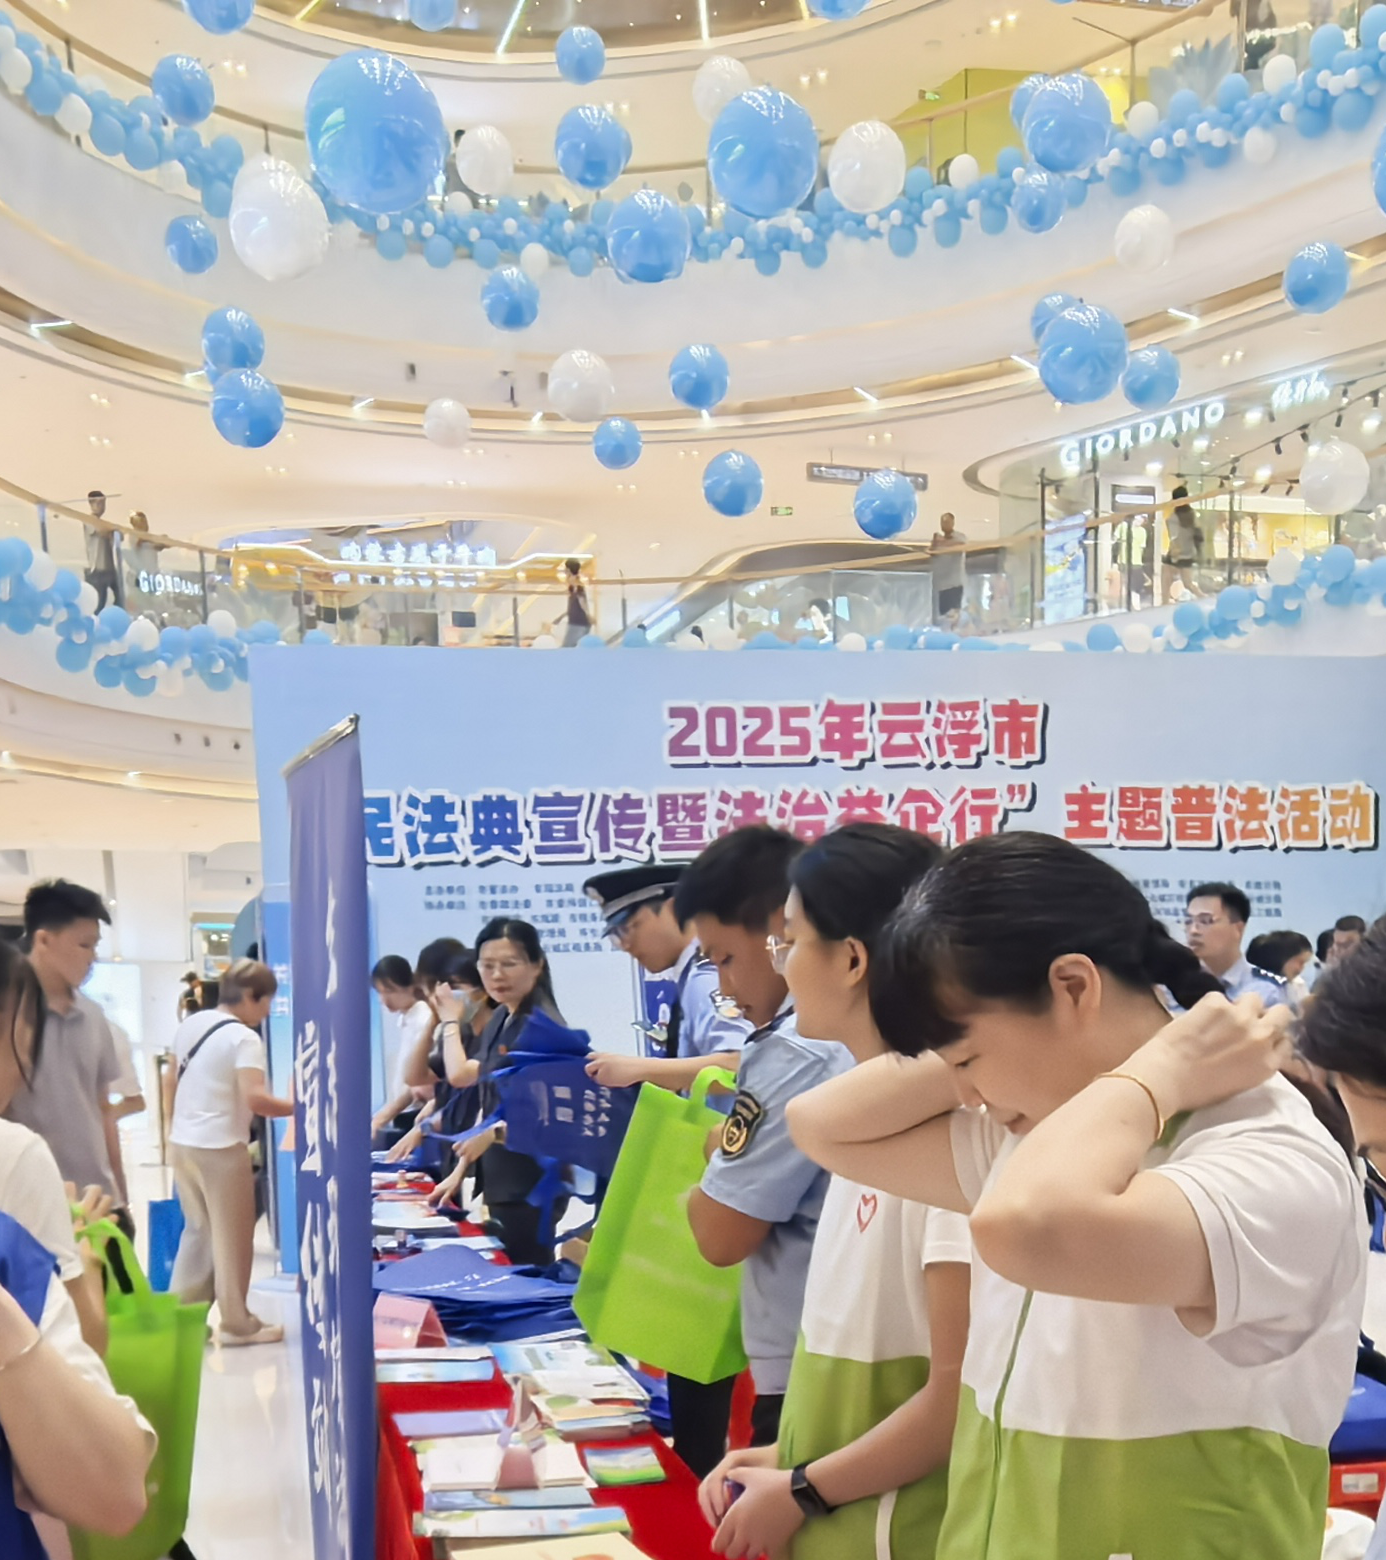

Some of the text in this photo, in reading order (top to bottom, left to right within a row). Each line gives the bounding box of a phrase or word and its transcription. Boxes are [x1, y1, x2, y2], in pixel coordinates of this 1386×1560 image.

[1059, 401, 1226, 467] GIORDANO
[665, 694, 1045, 765] 2025年云浮市
[1063, 783, 1374, 846] 主题普法活动
